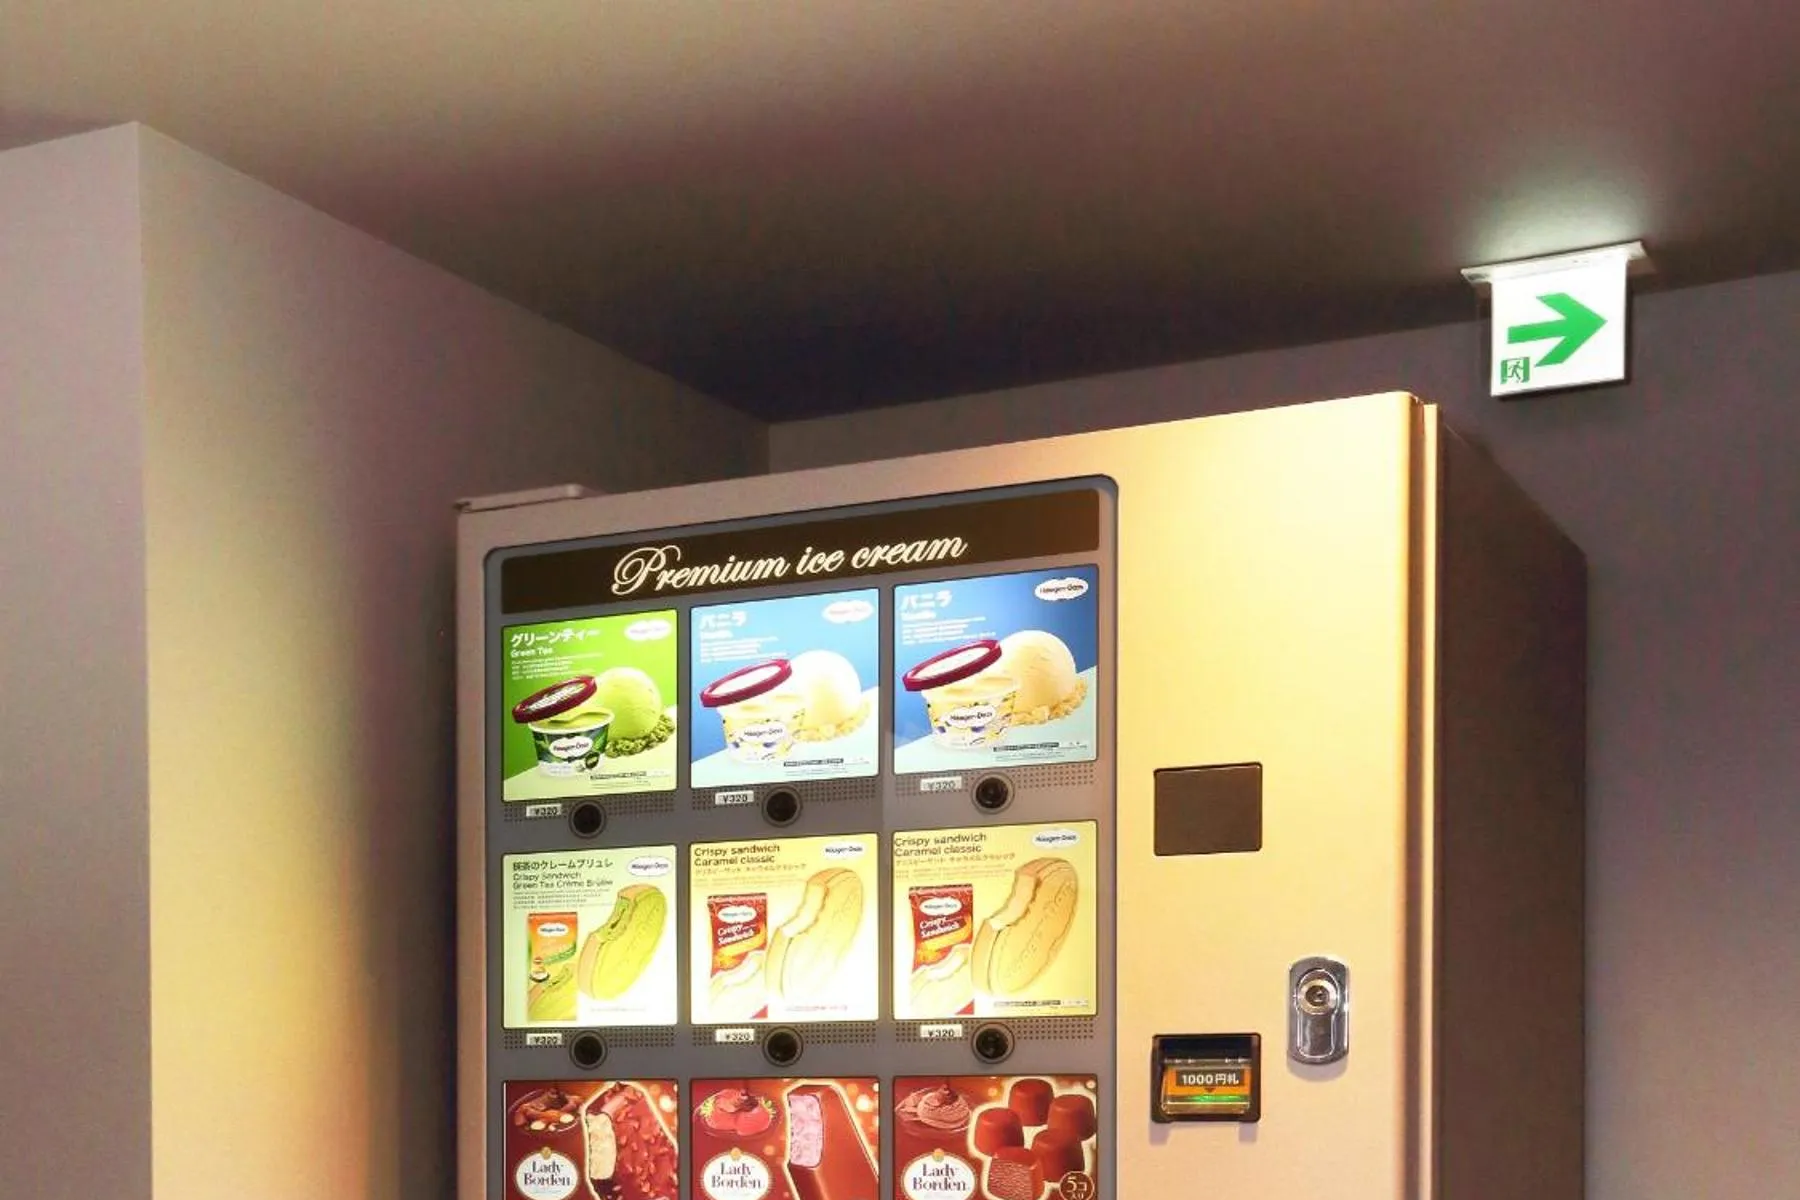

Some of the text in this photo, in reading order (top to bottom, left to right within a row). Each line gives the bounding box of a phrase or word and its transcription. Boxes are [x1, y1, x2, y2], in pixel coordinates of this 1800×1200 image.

[611, 536, 968, 595] Premium ice cream
[902, 590, 951, 609] バニラ
[511, 629, 599, 648] グリーンティー
[722, 794, 748, 802] ¥320
[894, 833, 986, 848] Crispy sandwich
[694, 844, 780, 859] Crispy sandwich
[894, 845, 982, 857] Caramel classic
[694, 854, 775, 867] Caramel classic
[726, 1031, 750, 1040] ¥320
[928, 1029, 955, 1038] ¥320
[1181, 1073, 1239, 1086] 1000円札
[532, 1161, 564, 1175] Lady
[720, 1163, 754, 1177] Lady
[922, 1163, 958, 1178] Lady
[524, 1173, 571, 1186] Borden
[711, 1174, 761, 1188] Borden
[912, 1176, 966, 1191] Borden
